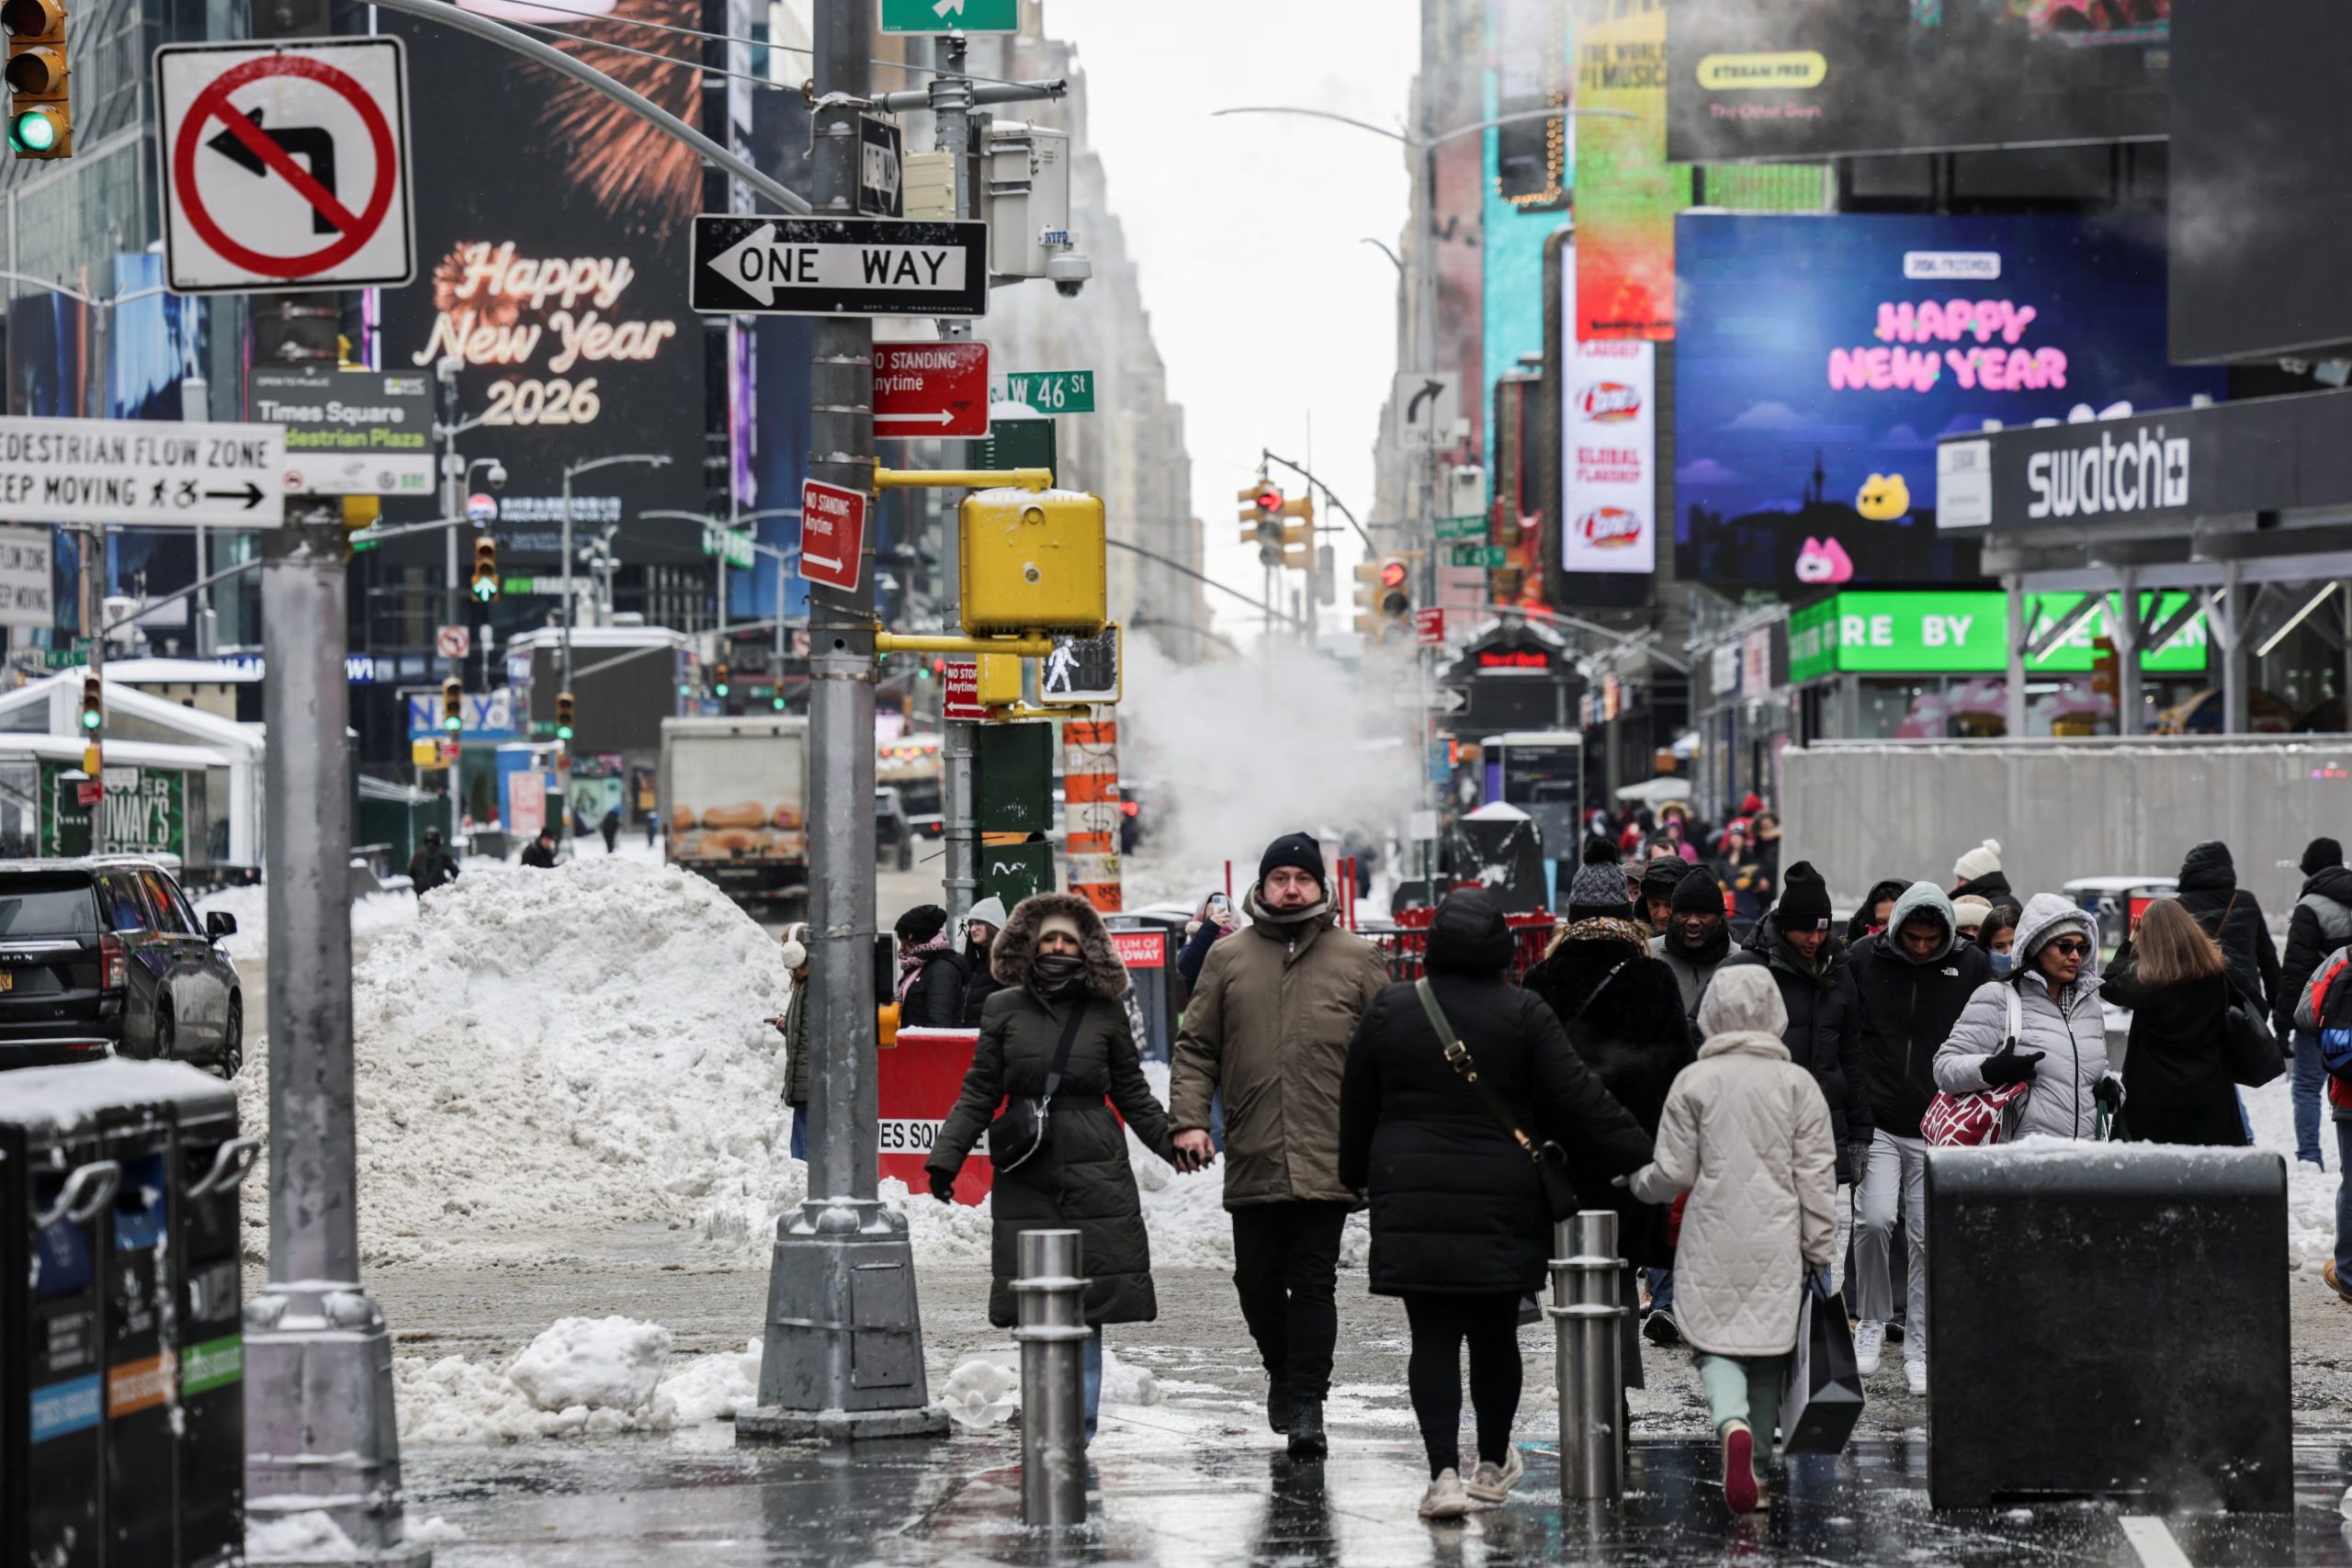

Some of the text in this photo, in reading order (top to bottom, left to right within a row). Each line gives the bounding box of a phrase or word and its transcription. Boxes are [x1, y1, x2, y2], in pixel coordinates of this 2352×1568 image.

[1045, 231, 1069, 244] NYPD
[455, 241, 635, 310] Happy
[740, 247, 947, 286] ONE WAY
[1878, 299, 2037, 344] HAPPY
[412, 310, 677, 374] New Year
[890, 352, 956, 369] STANDING
[1827, 345, 2068, 393] NEW YEAR
[874, 374, 923, 395] nytime
[1012, 374, 1086, 408] W 46 St
[257, 400, 405, 426] Times Square
[482, 378, 601, 425] 2026
[369, 427, 425, 448] Plaza
[136, 436, 198, 468] FLOW
[208, 439, 269, 469] ZONE
[2028, 427, 2164, 518] swatch
[0, 473, 135, 506] EP MOVING
[806, 491, 850, 516] NO STANDING
[805, 513, 833, 536] Anytime
[1923, 615, 1973, 647] BY
[47, 651, 57, 665] W
[948, 668, 958, 680] NO
[947, 682, 978, 694] Anytime
[1143, 938, 1159, 949] OF
[878, 1122, 905, 1148] ES
